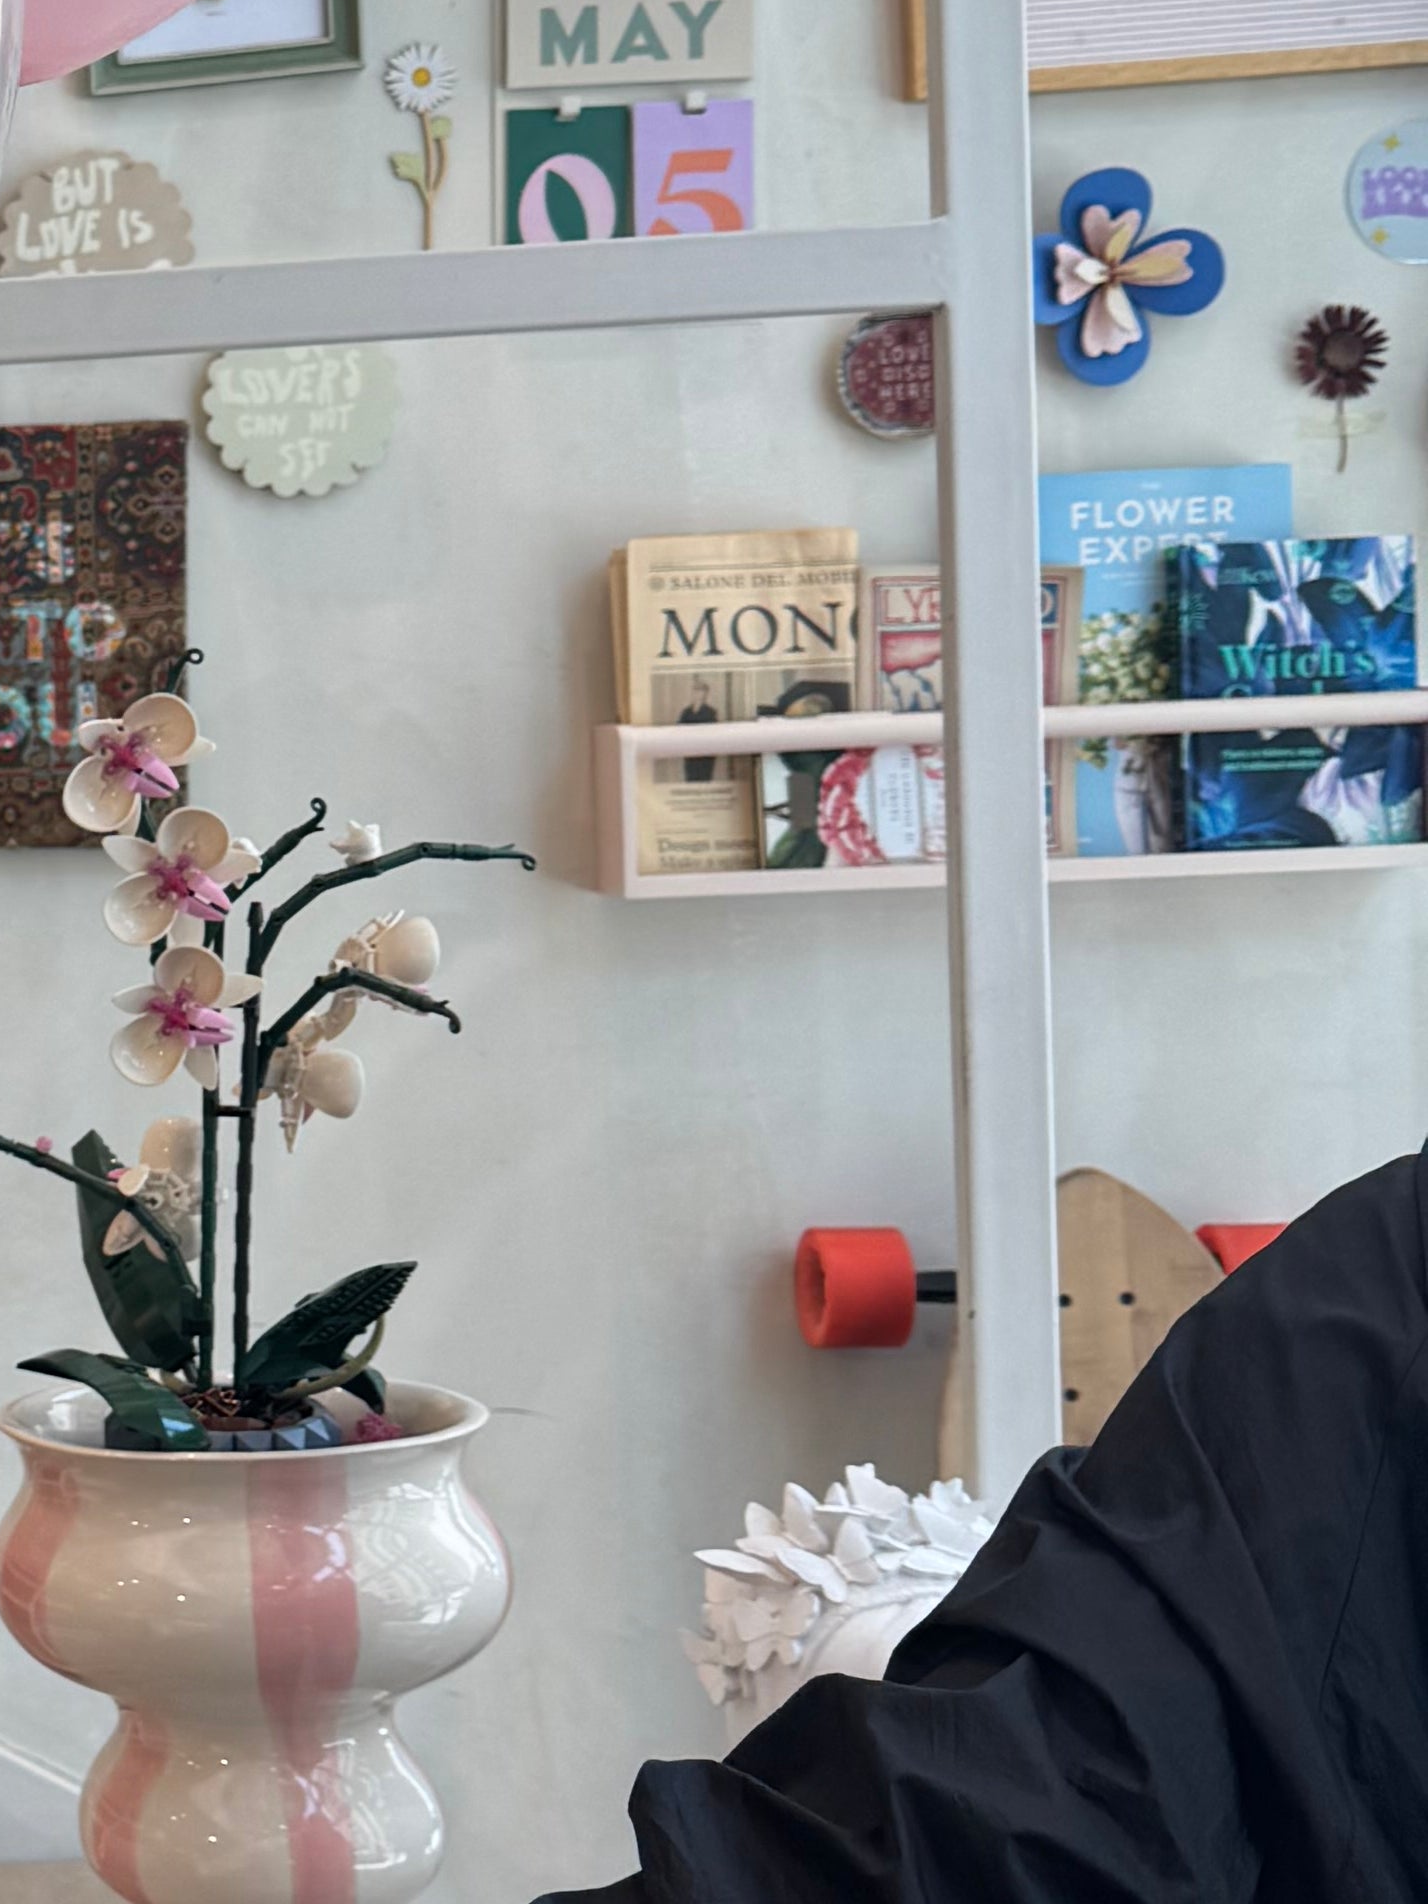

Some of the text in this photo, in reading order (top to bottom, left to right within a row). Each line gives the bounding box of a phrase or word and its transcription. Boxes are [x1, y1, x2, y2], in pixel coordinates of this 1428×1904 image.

[539, 0, 723, 67] MAY
[52, 157, 120, 214] BUT
[15, 206, 155, 262] LOVE IS
[216, 348, 362, 406] LOVERS
[308, 402, 356, 433] NOT
[1070, 495, 1236, 532] FLOWER
[657, 600, 858, 658] MON
[1217, 639, 1377, 683] Witch's
